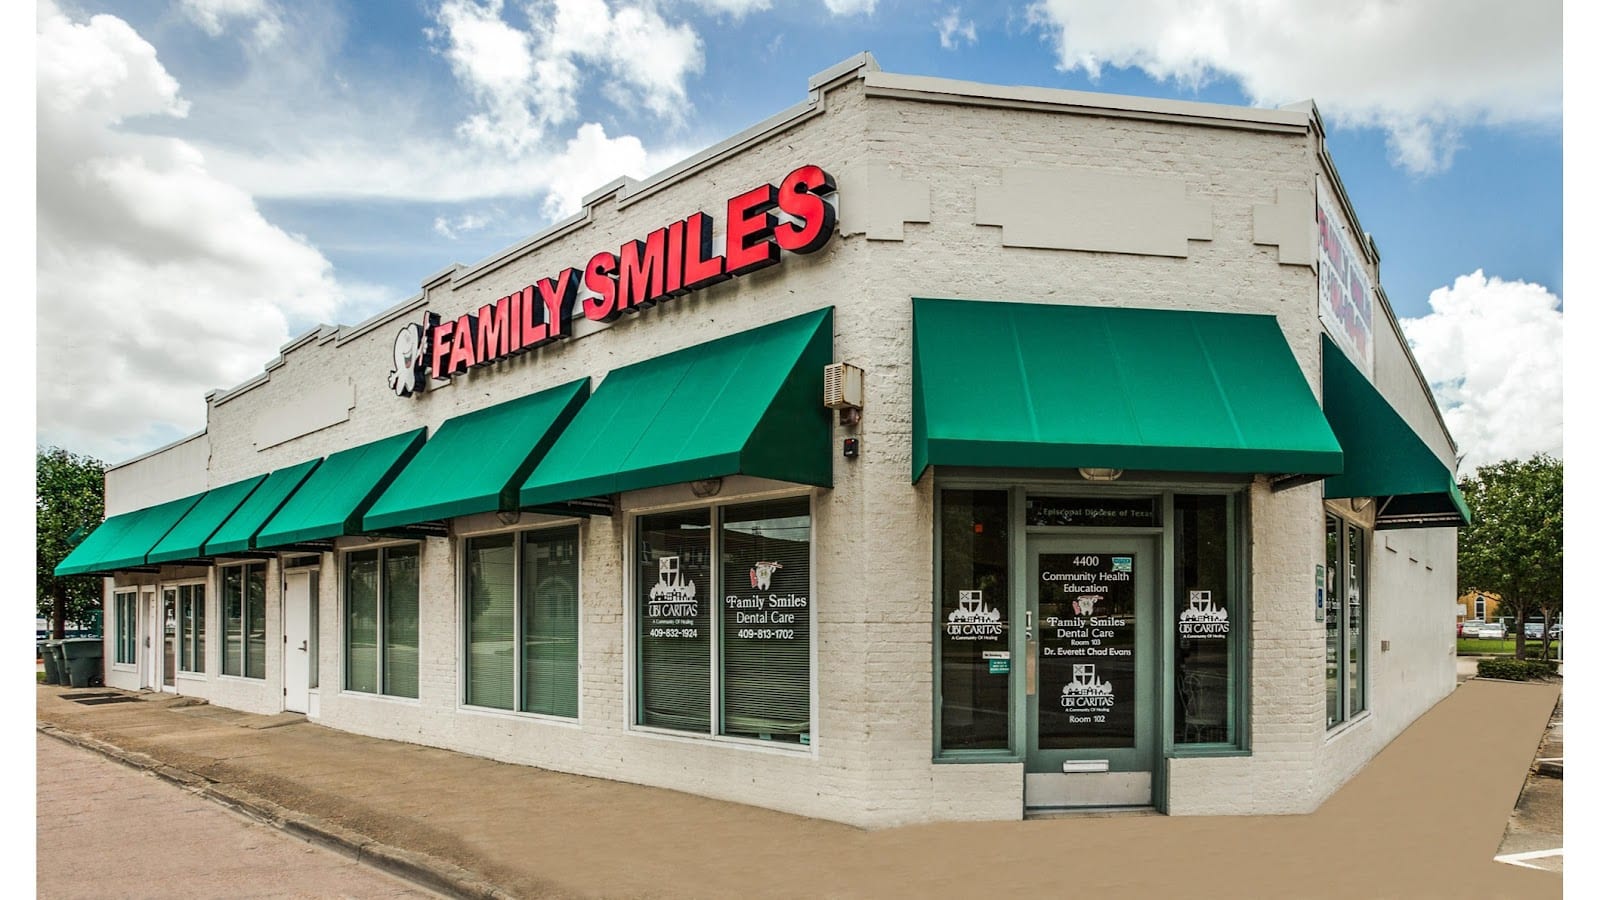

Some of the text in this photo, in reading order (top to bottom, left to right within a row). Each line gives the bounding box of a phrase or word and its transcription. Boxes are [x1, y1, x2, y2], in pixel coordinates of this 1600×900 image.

[432, 165, 836, 379] FAMILY SMILES
[1043, 508, 1082, 518] Episcopal
[1084, 508, 1117, 518] Diocese
[1119, 509, 1128, 517] of
[1073, 556, 1099, 566] 4400
[1042, 571, 1130, 583] Community Health
[1063, 583, 1108, 593] Education
[725, 594, 807, 610] Family Smiles
[649, 604, 698, 616] UBI CARITAS
[736, 611, 795, 624] Dental Care
[1046, 617, 1125, 628] Family Smiles
[650, 628, 698, 638] 409-832-1924
[947, 625, 1002, 634] UBI CARITAS
[1057, 629, 1115, 638] Dental Care
[1179, 624, 1230, 633] UBI CARITAS
[738, 629, 794, 639] 409-813-1702
[1044, 647, 1131, 656] Dr. Everett Chad Evans
[1061, 697, 1114, 707] UBI CARITAS
[1069, 715, 1105, 723] Room 102
